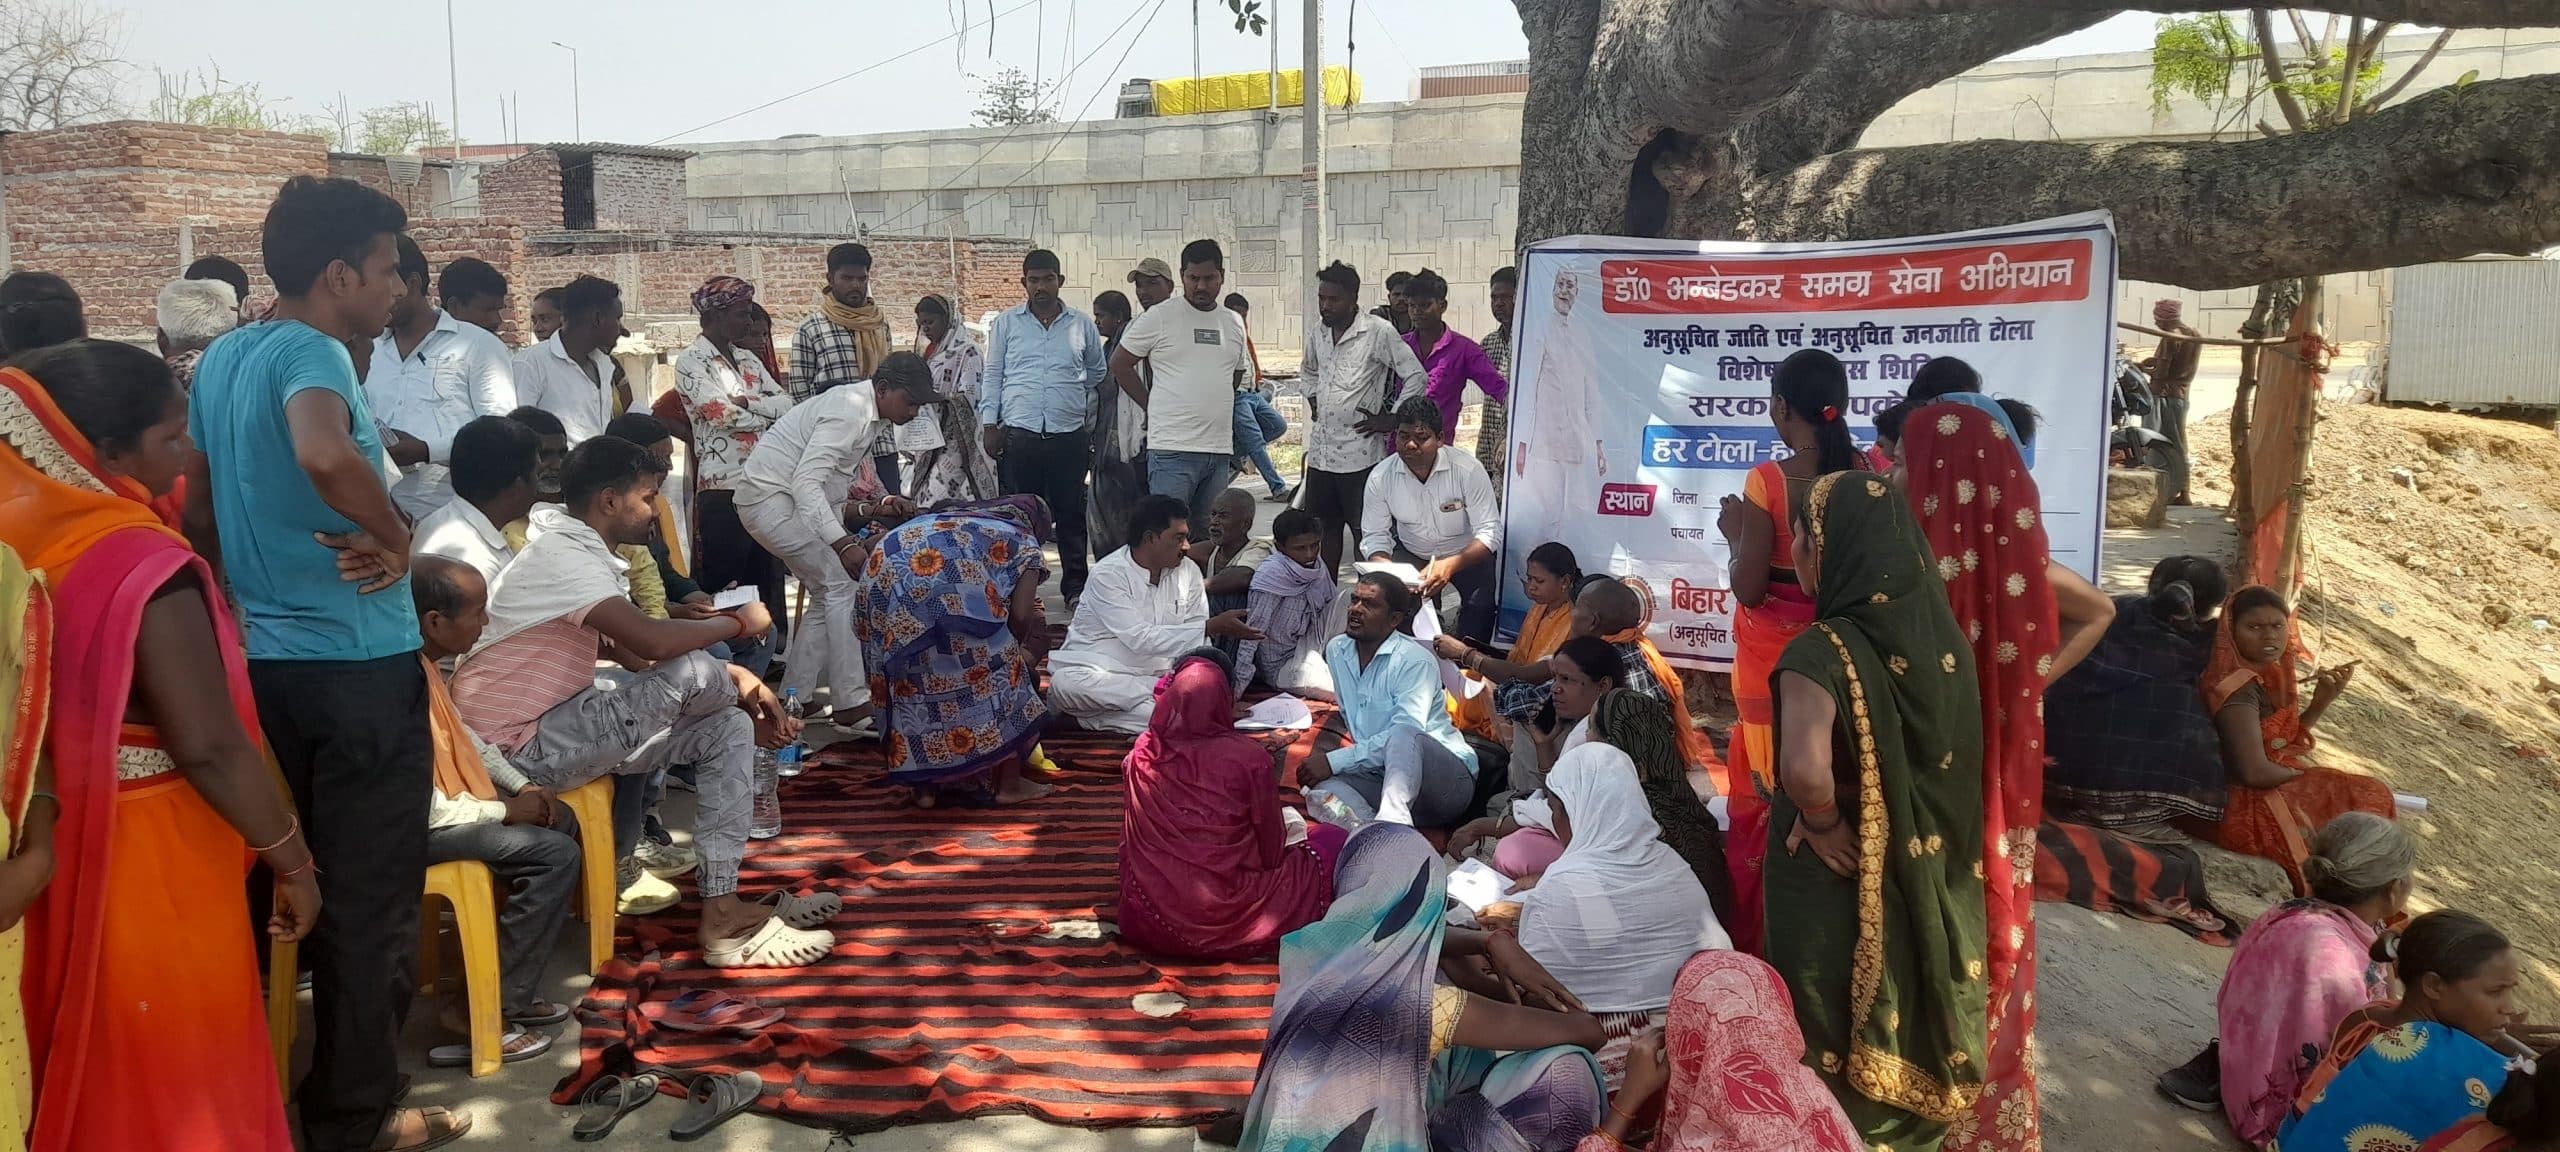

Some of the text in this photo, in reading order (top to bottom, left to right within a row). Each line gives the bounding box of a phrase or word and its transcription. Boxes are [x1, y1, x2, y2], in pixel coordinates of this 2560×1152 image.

[1666, 264, 1784, 301] अम्बेडकर
[1801, 271, 1872, 298] समग्र
[1889, 257, 1943, 295] सेवा
[1960, 252, 2074, 292] अभियान
[1644, 316, 2035, 354] अनुसूचित जाति एवं अनुसूचित जनजाति टोला
[1651, 437, 1692, 463] हर
[1604, 488, 1699, 512] स्थान जिला
[1671, 523, 1705, 540] पंचायत
[1671, 577, 1731, 614] बिहार
[1669, 622, 1727, 648] (अनुसूचित
